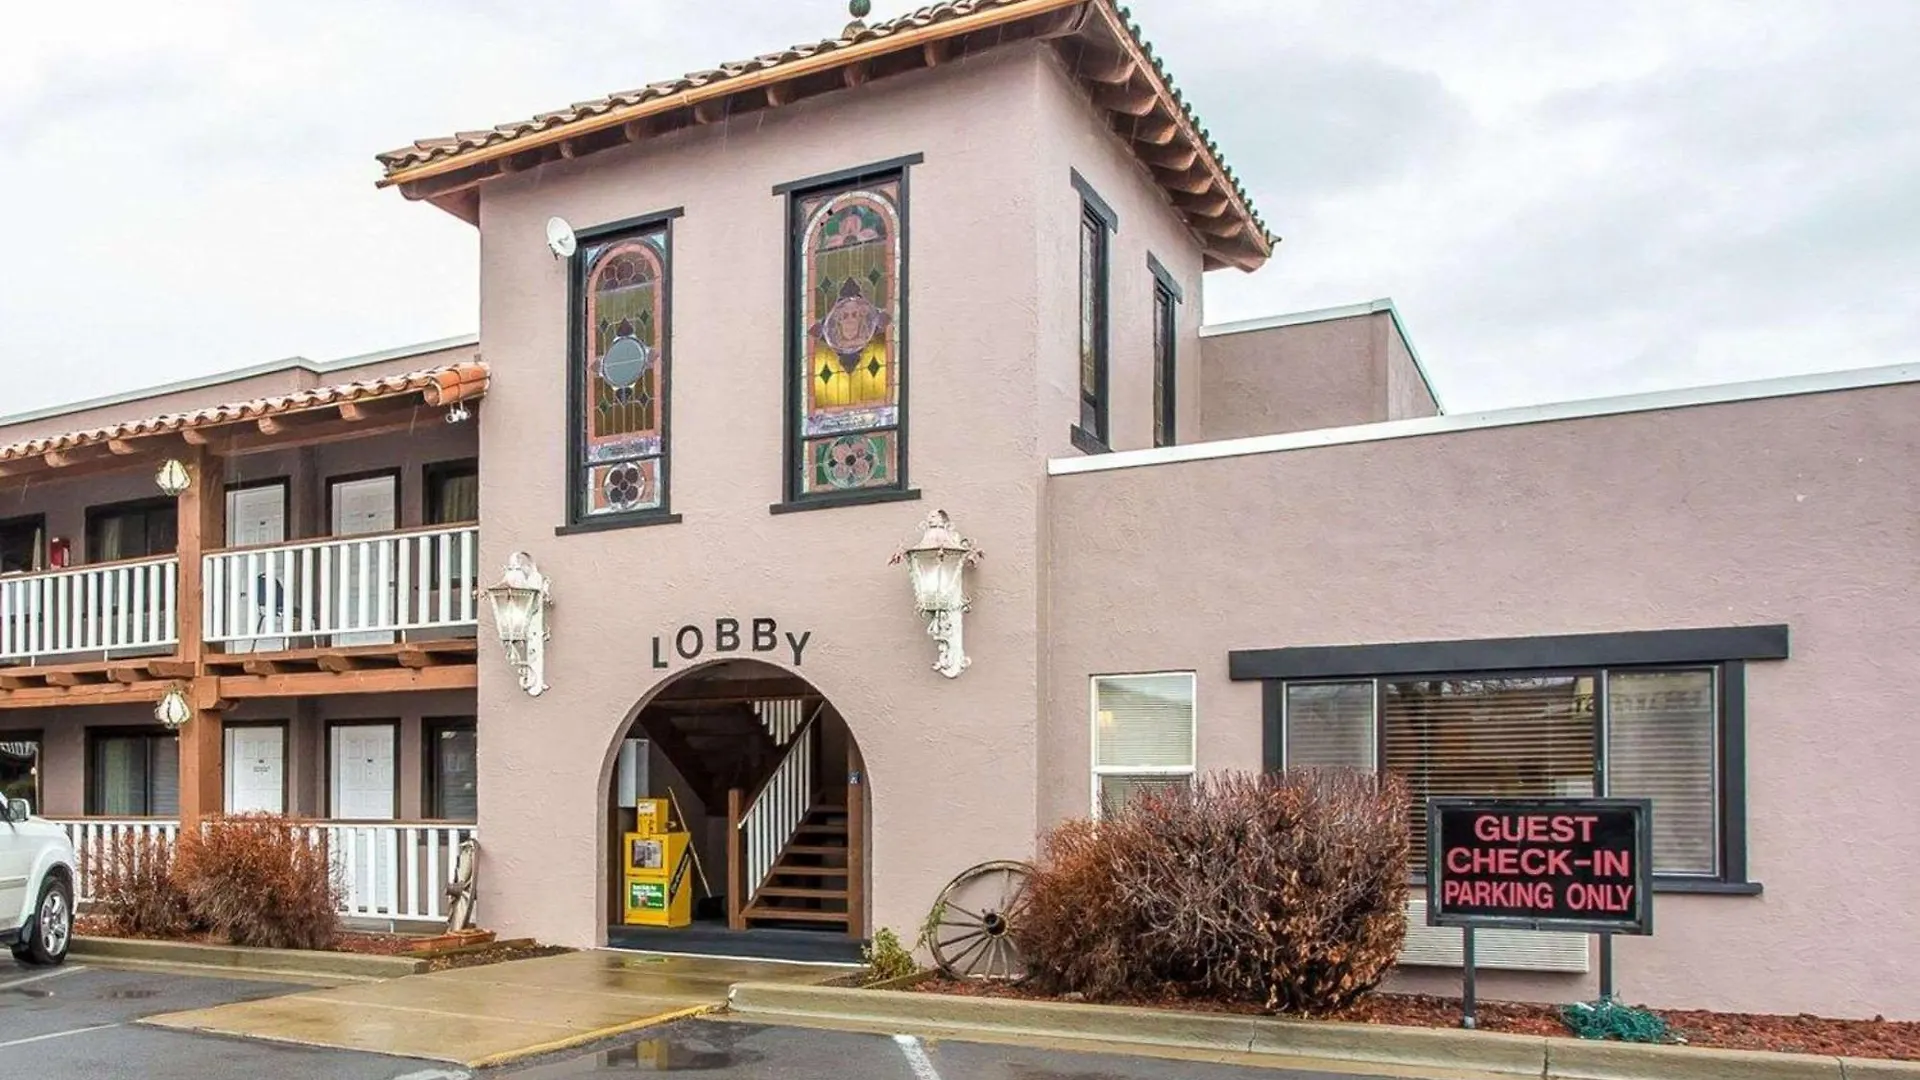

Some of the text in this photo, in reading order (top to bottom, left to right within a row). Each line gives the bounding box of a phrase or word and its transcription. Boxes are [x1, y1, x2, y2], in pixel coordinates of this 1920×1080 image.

[652, 617, 811, 669] LOBBY
[1474, 815, 1598, 842] GUEST
[1447, 847, 1629, 877] CHECK-IN
[1444, 880, 1634, 911] PARKING ONLY
